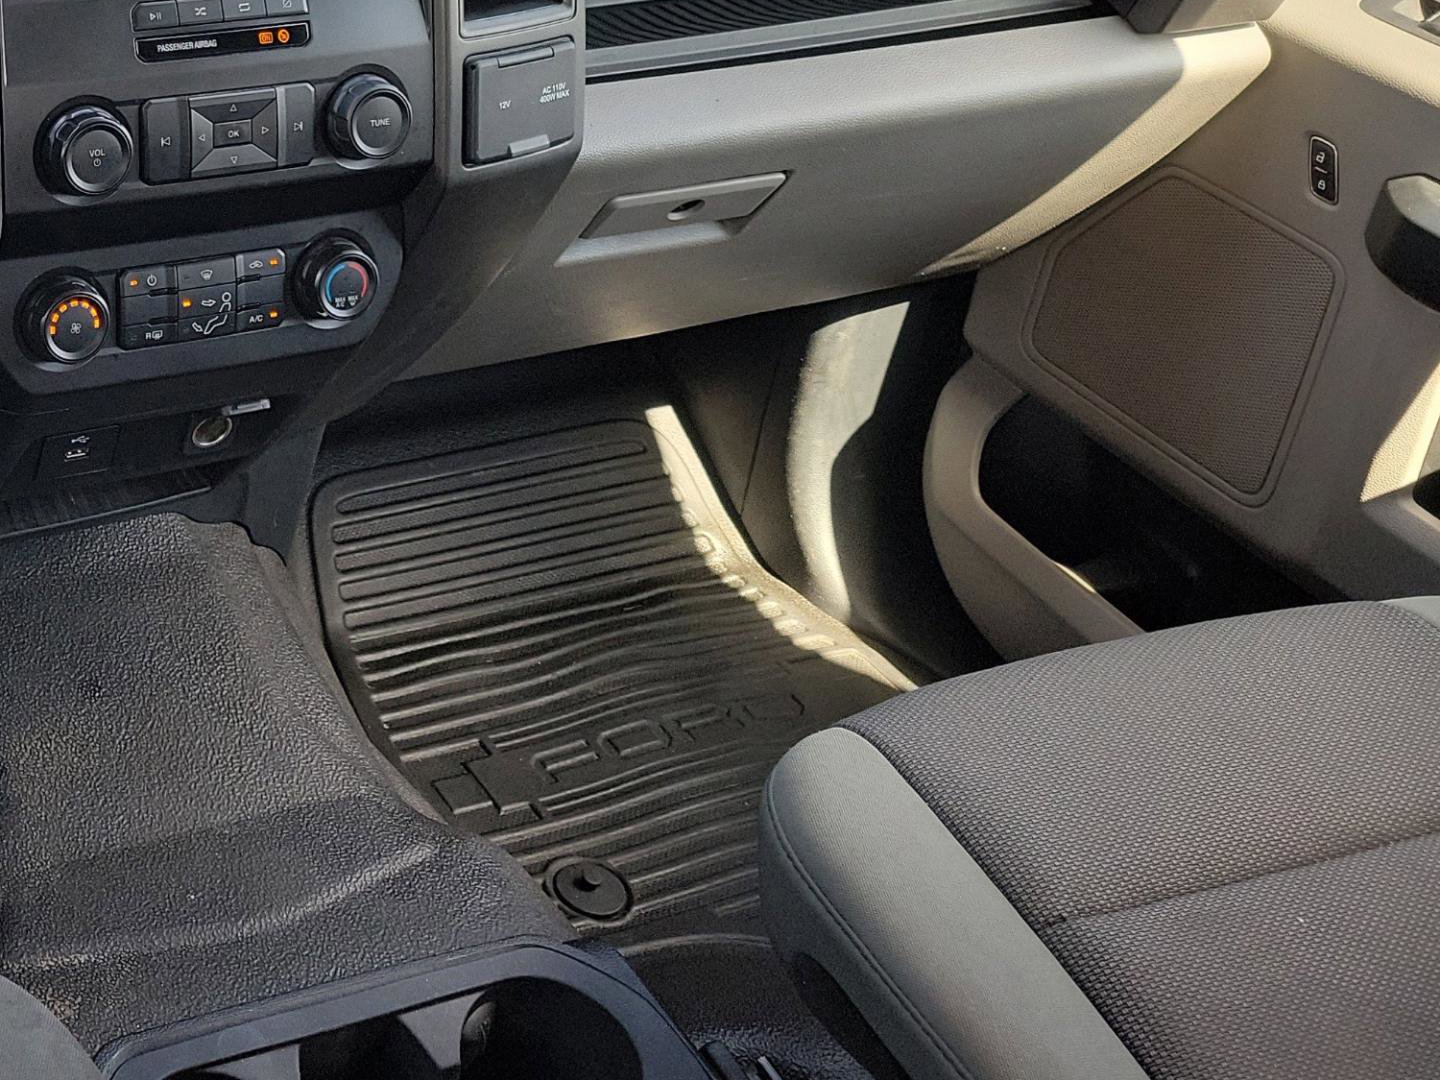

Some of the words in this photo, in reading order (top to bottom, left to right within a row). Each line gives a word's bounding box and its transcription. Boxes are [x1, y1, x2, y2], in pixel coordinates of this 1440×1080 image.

[157, 41, 194, 53] PASSENGER
[194, 39, 218, 49] AIRBAG
[499, 100, 511, 110] 12V
[370, 118, 391, 128] TUNE
[227, 130, 240, 138] OK
[89, 149, 106, 158] VOL
[249, 315, 263, 323] A/C
